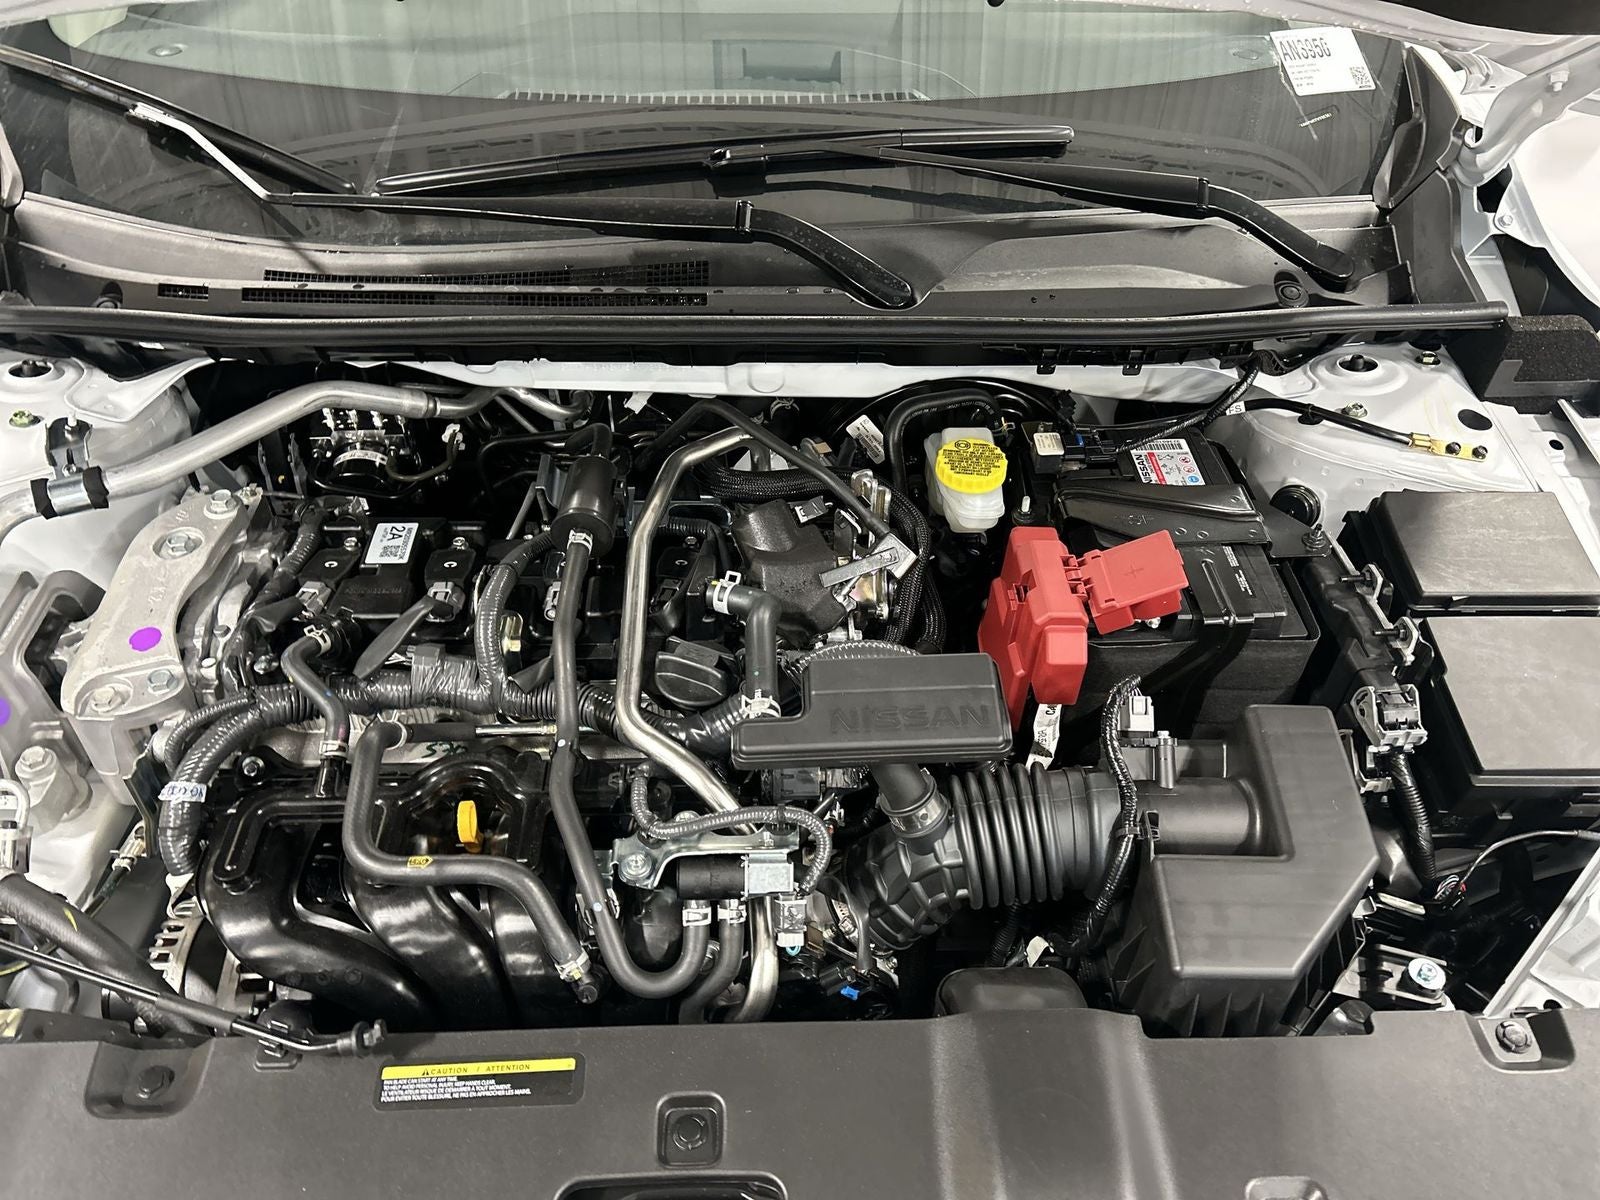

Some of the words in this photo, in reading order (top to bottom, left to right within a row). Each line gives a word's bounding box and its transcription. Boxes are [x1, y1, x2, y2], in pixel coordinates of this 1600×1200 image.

[387, 526, 406, 541] 2A
[830, 704, 991, 734] NISSAN
[430, 1066, 468, 1076] CAUTION
[485, 1063, 531, 1073] ATTENTION
